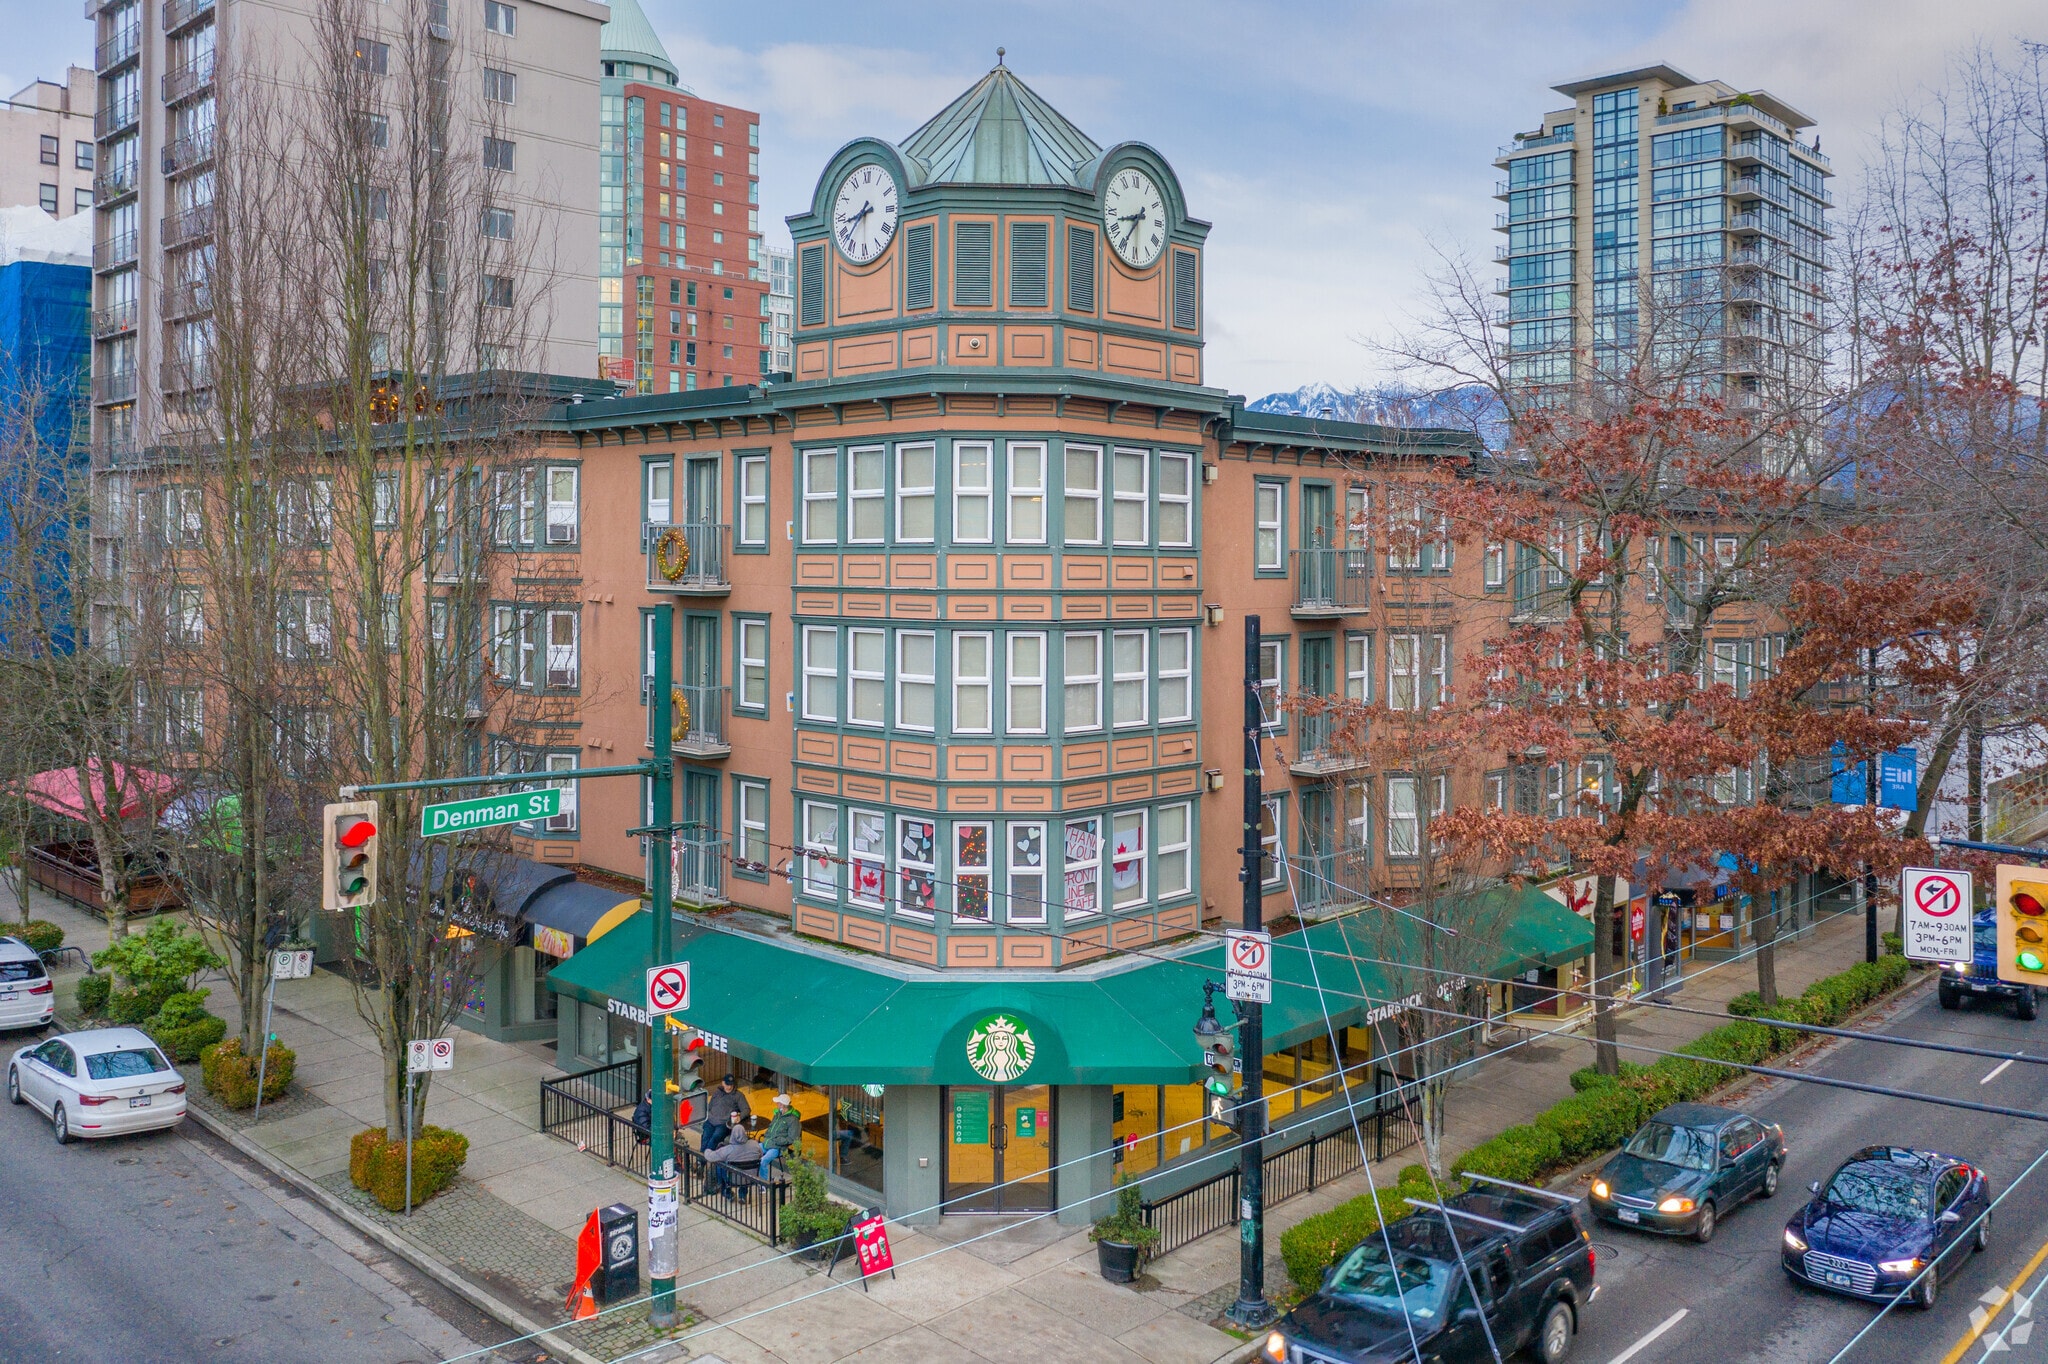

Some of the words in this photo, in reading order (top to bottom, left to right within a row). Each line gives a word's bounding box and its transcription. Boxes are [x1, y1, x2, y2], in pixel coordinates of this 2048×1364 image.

[433, 803, 518, 829] Denman
[528, 795, 550, 815] St
[1069, 842, 1092, 861] YOU
[1064, 867, 1096, 886] RONT
[1068, 884, 1084, 900] INE
[1366, 991, 1423, 1026] STARBUCK
[688, 1026, 728, 1054] FFEE
